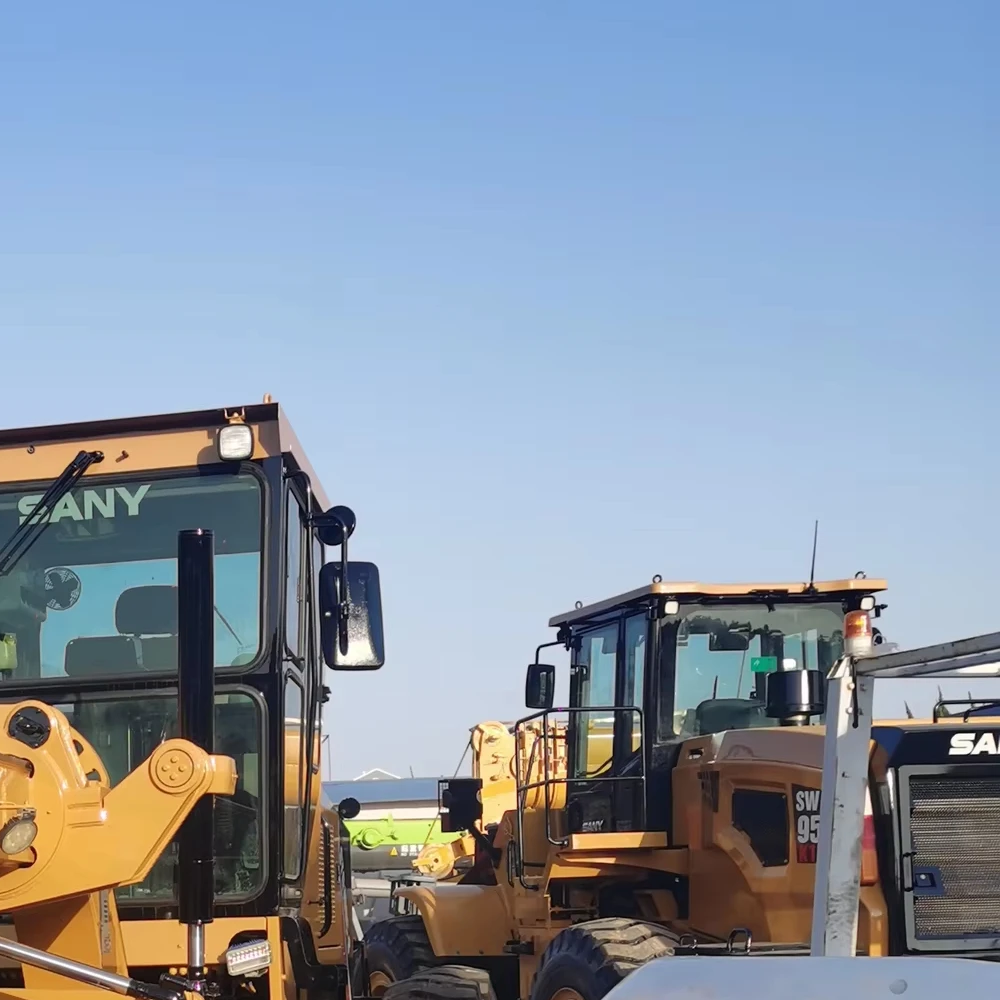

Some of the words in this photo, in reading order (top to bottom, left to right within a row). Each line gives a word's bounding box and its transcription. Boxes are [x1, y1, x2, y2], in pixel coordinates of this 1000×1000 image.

[17, 484, 151, 525] SANY
[948, 732, 1000, 755] SA
[795, 790, 820, 811] SW
